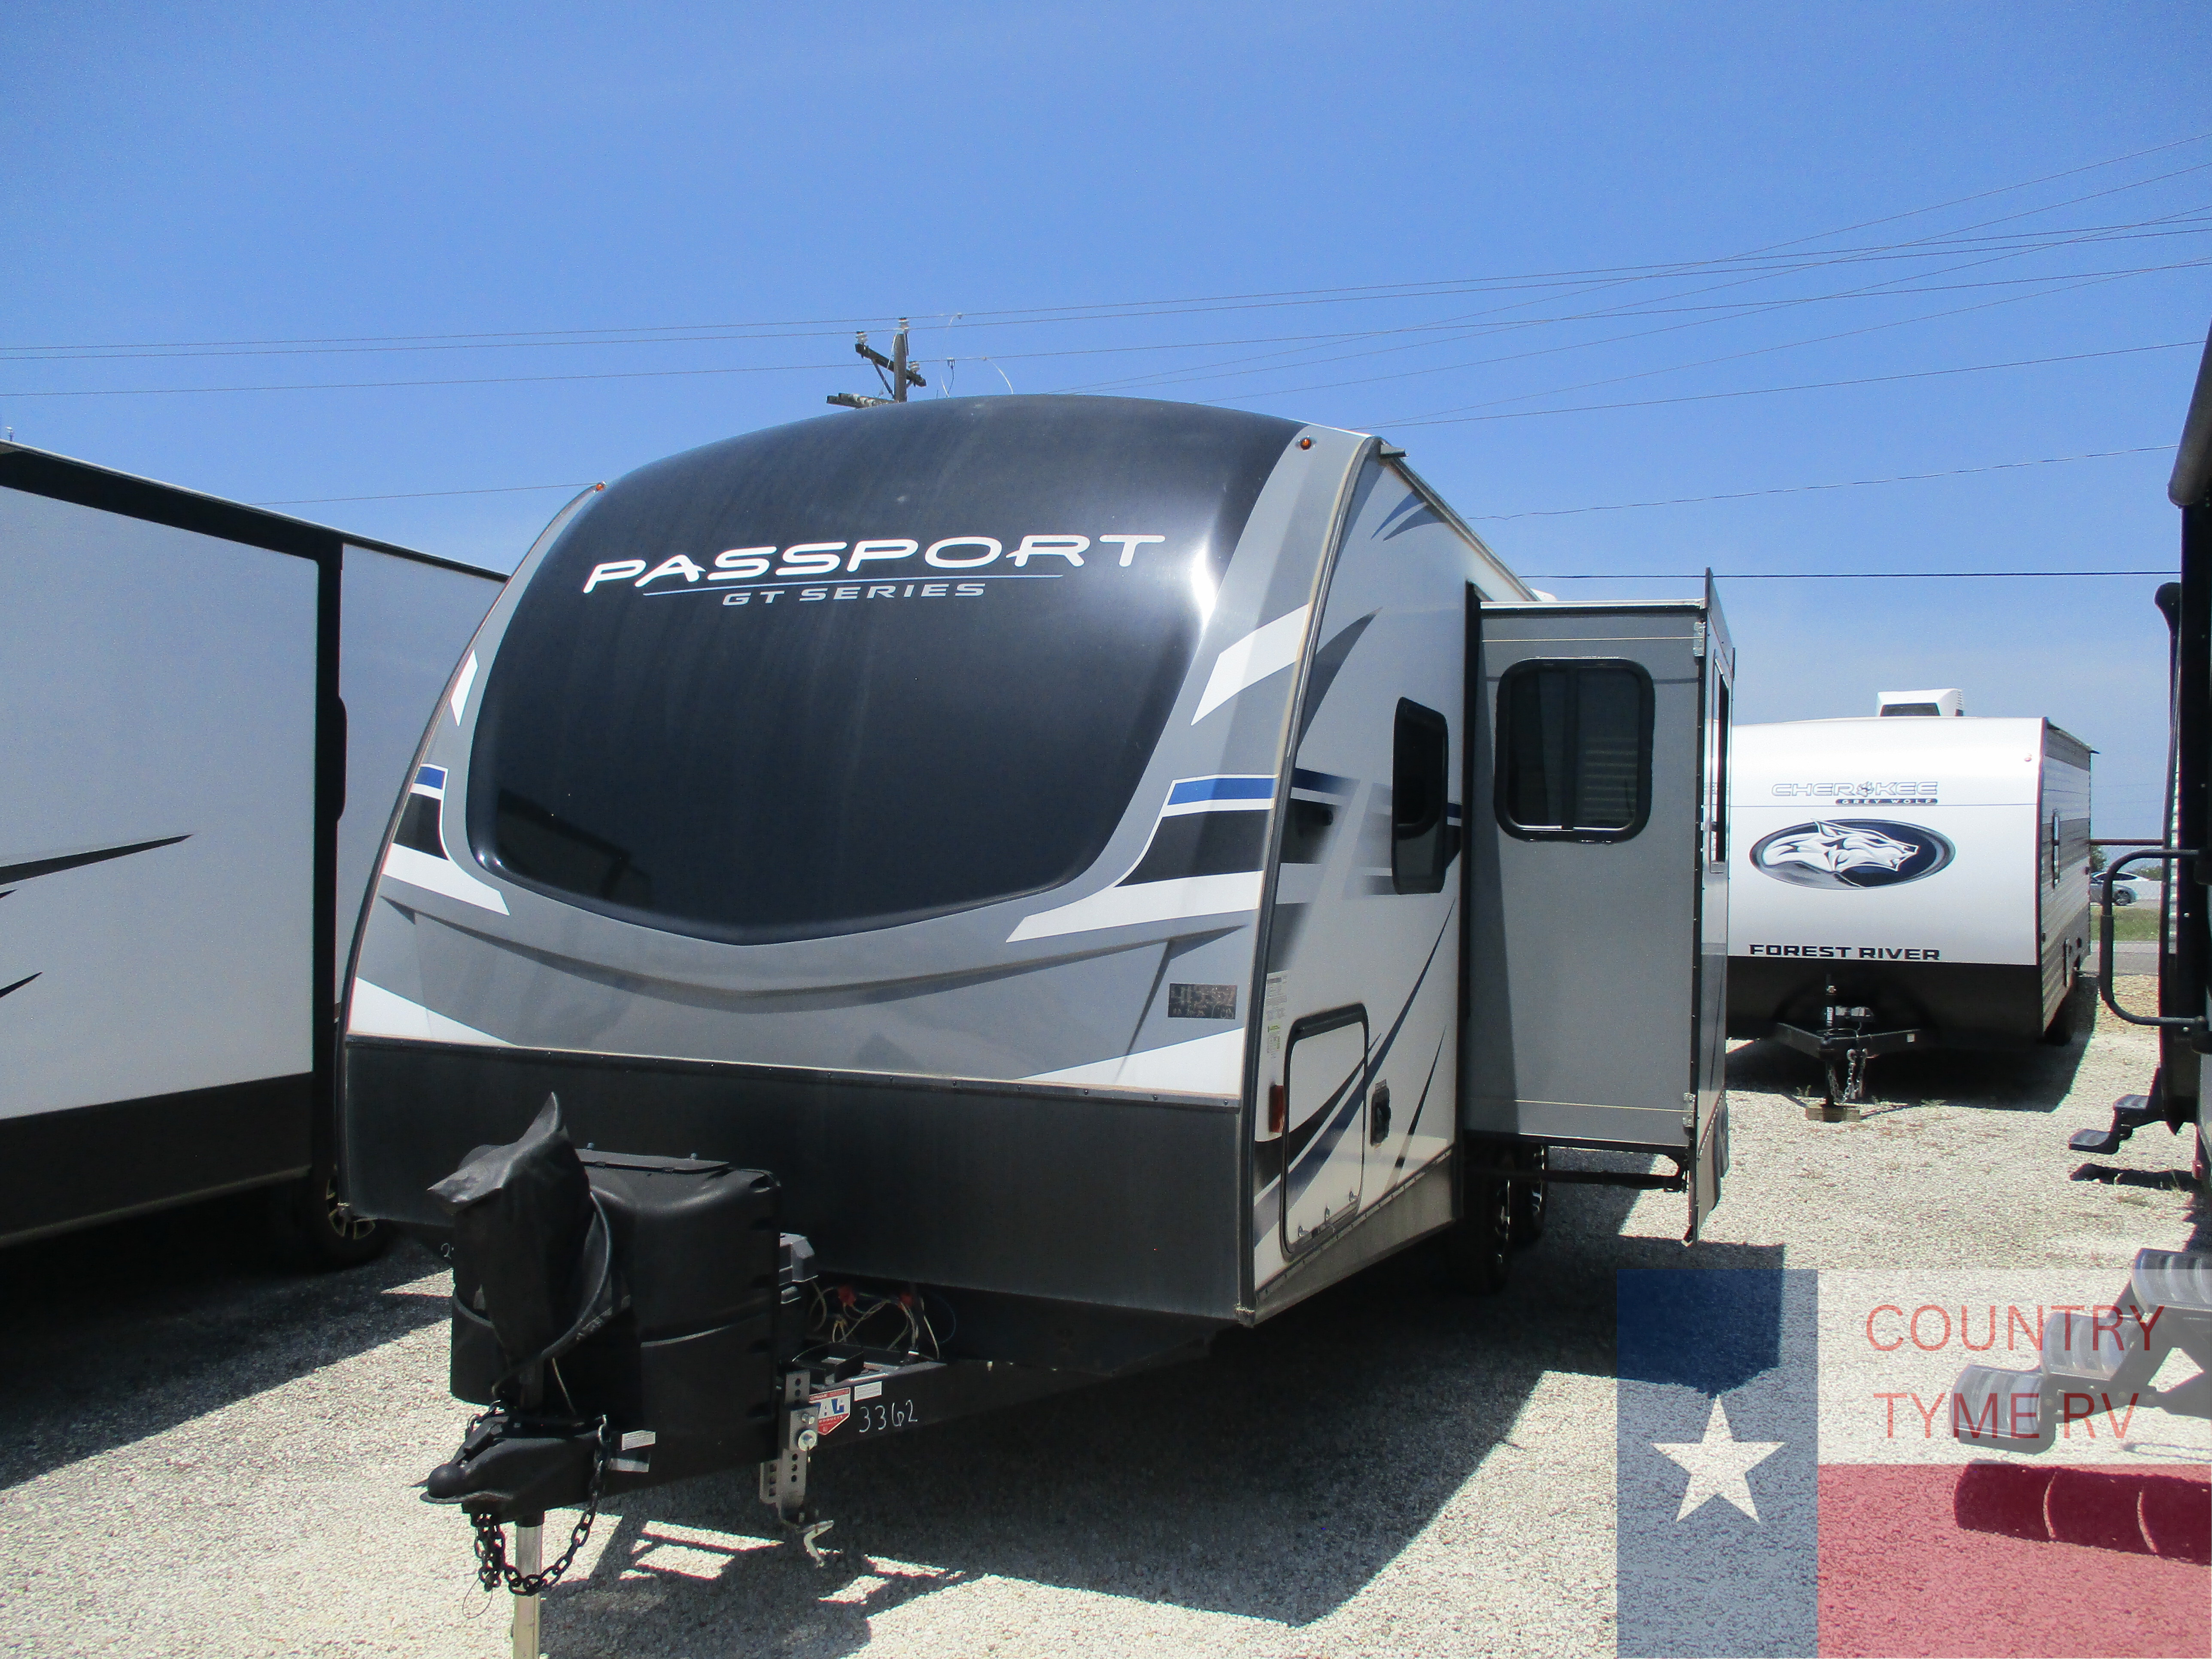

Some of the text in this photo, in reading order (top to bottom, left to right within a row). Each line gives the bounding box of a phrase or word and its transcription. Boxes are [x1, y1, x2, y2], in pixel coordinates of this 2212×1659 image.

[583, 534, 1166, 593] PASSPORT
[722, 583, 986, 606] GT SERIES
[1749, 944, 1941, 960] FOREST RIVER
[859, 1399, 918, 1433] 3362
